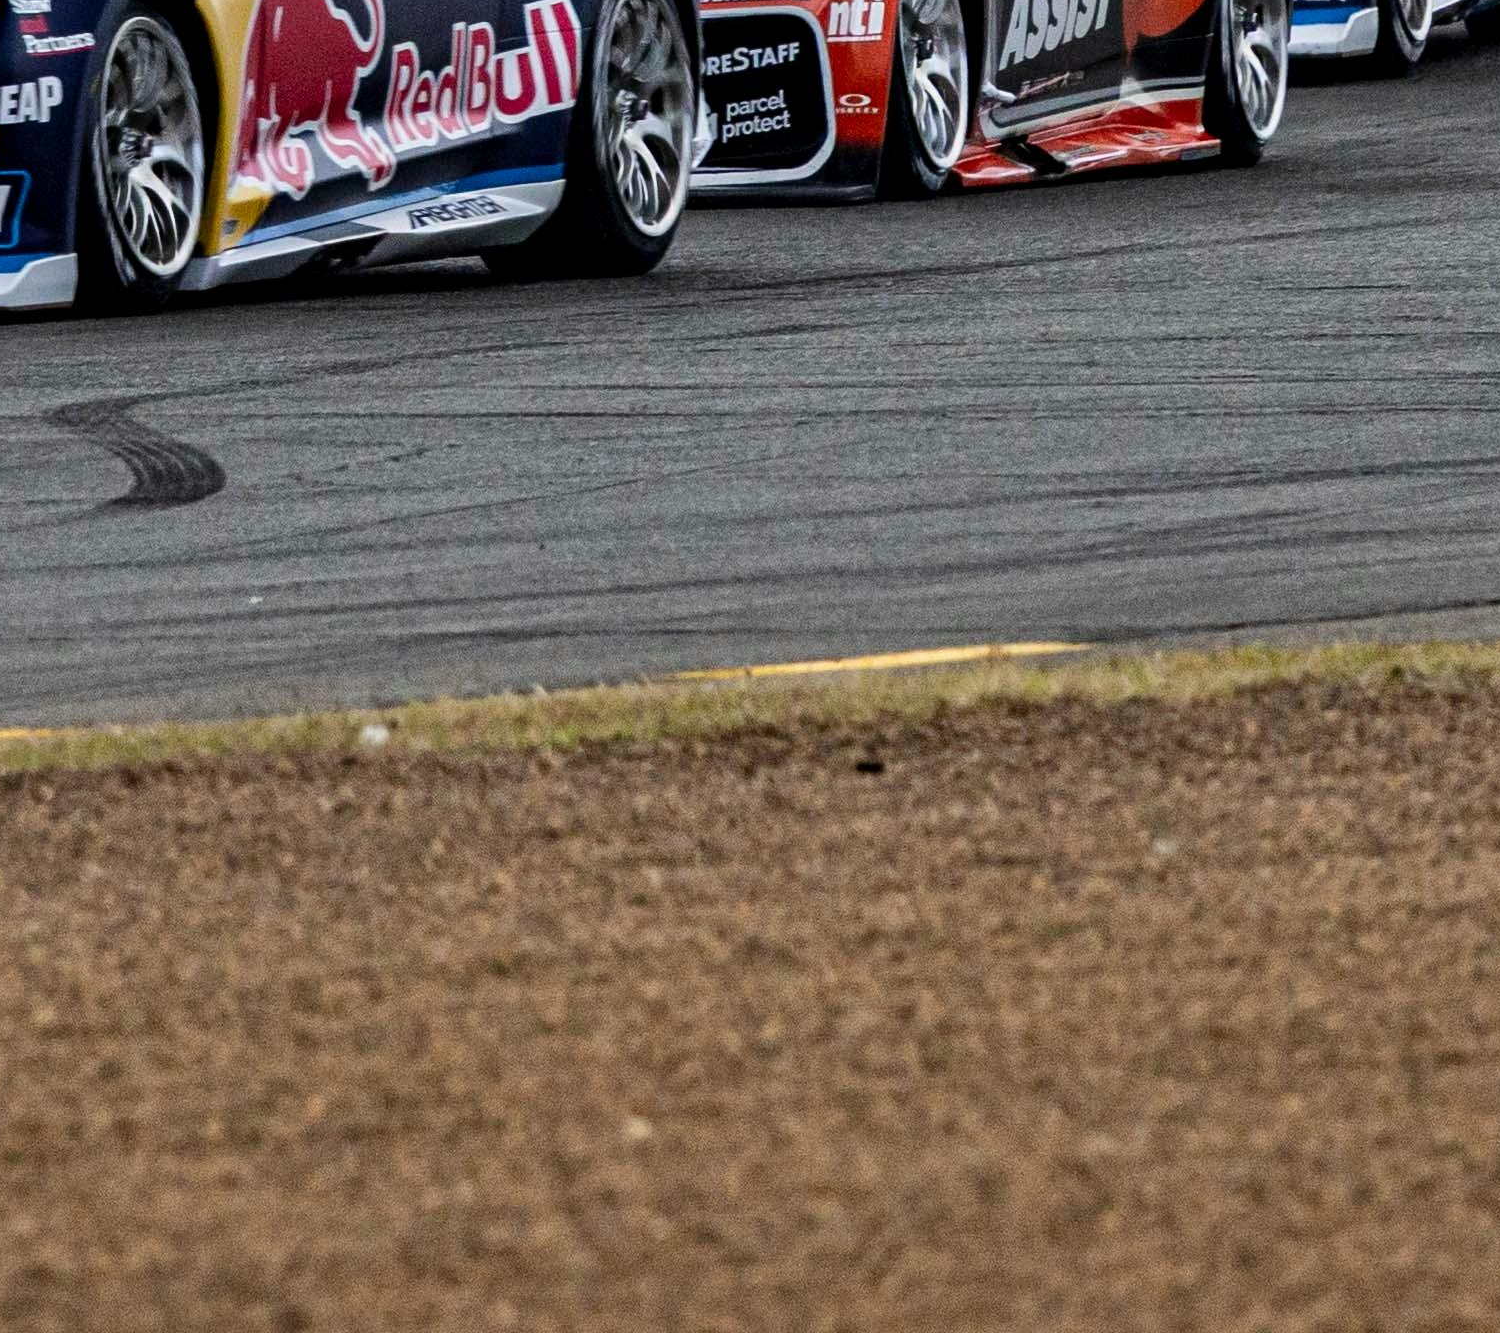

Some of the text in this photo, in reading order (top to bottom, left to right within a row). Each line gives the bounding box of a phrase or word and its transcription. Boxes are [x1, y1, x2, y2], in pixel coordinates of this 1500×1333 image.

[384, 20, 468, 153] Red
[725, 89, 787, 122] parcel
[721, 110, 791, 143] protect
